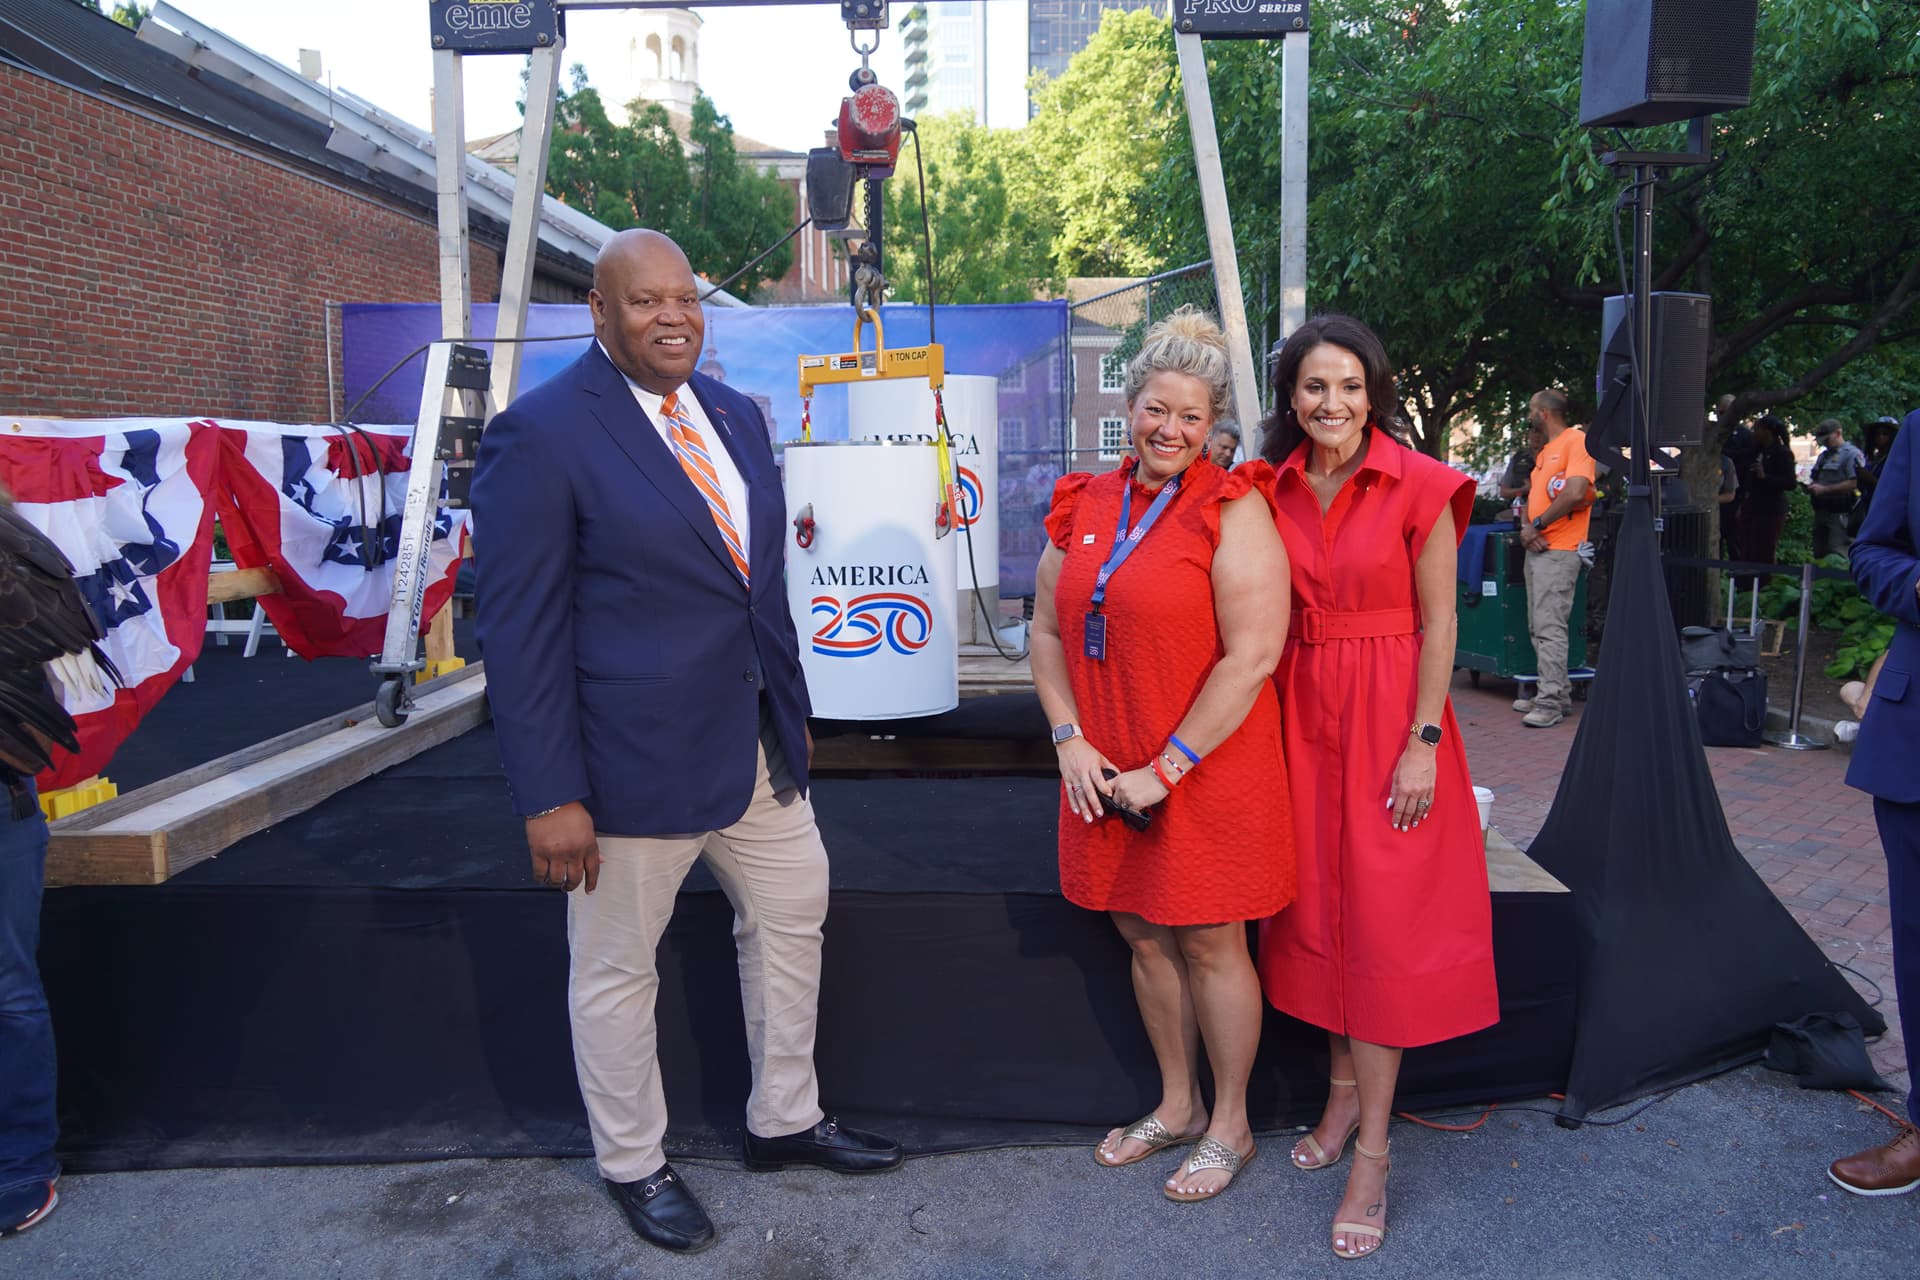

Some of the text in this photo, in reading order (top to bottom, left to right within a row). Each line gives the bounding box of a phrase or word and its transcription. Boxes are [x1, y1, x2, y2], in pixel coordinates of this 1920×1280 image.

[1258, 4, 1302, 14] SERIES
[889, 353, 894, 361] 1
[895, 352, 910, 361] TON
[395, 536, 415, 603] 11242851
[413, 519, 433, 618] United Rentals
[811, 564, 929, 587] AMERICA
[811, 592, 934, 658] 250
